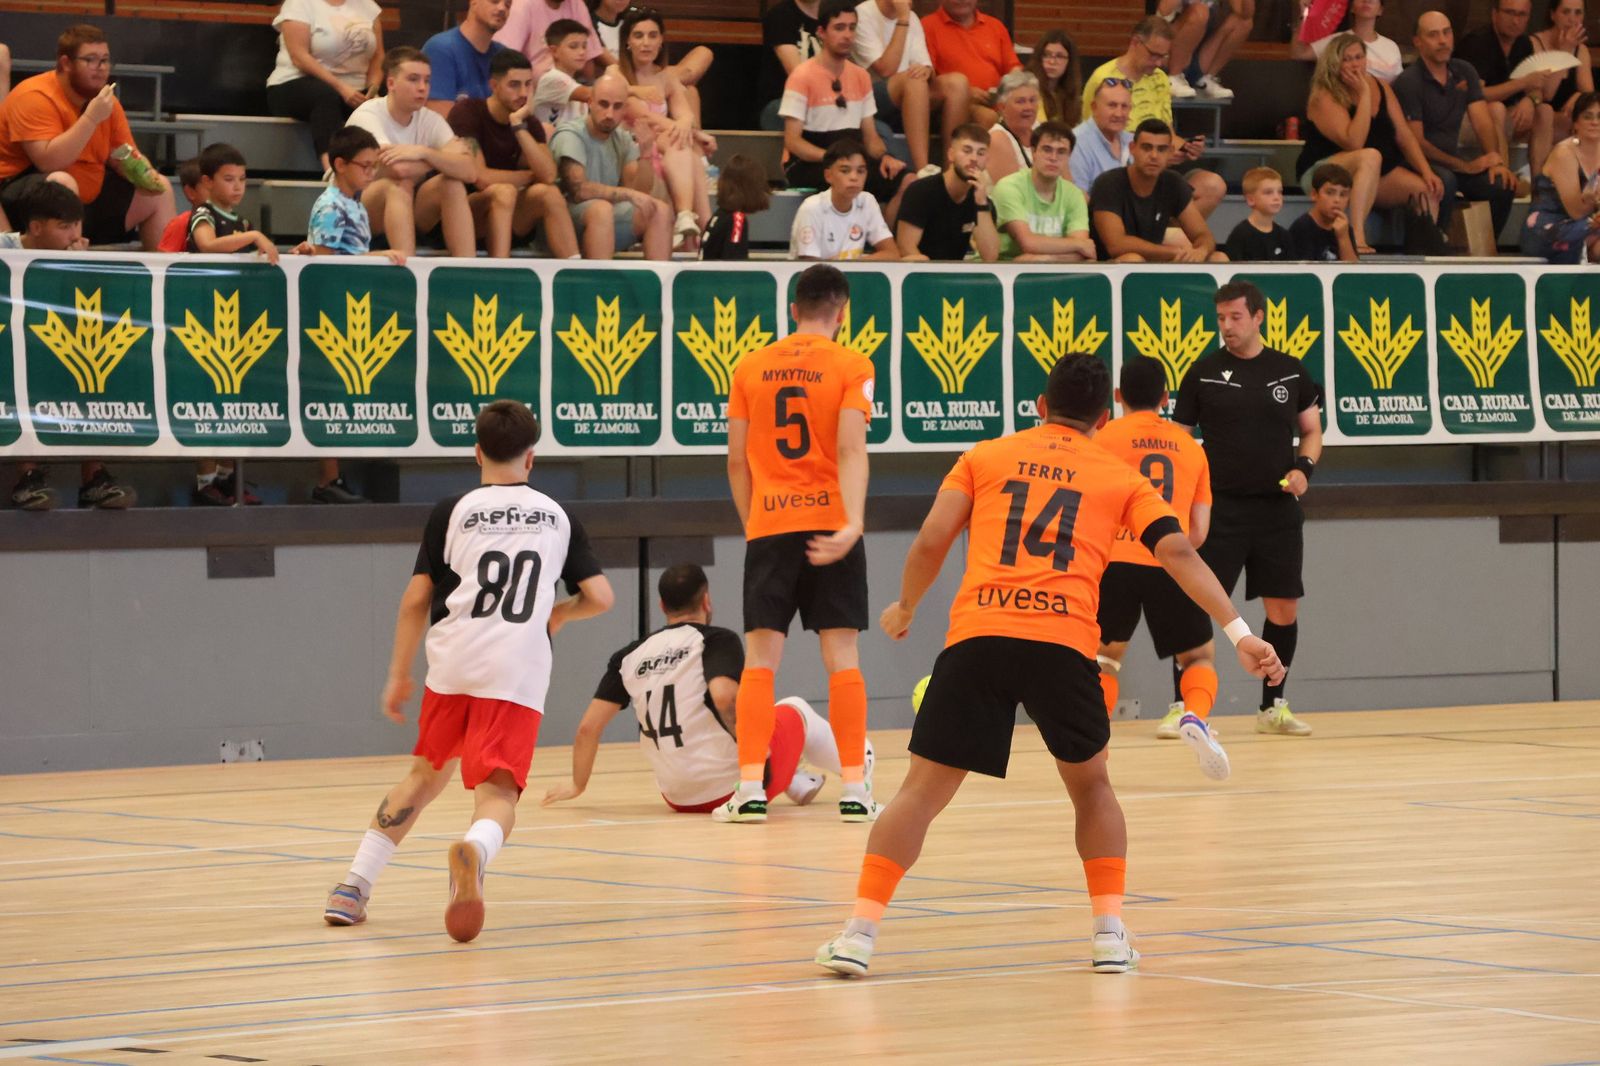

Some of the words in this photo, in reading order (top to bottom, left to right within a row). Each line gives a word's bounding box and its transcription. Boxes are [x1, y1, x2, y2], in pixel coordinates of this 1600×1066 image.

[762, 369, 823, 383] MYKYTIUK
[905, 401, 946, 419] CAJA
[950, 401, 1000, 417] RURAL
[1018, 400, 1041, 417] CA
[1340, 397, 1374, 412] CAJA
[1378, 396, 1427, 412] RURAL
[1443, 395, 1482, 411] CAJA
[1482, 394, 1530, 410] RURAL
[1545, 394, 1581, 410] CAJA
[35, 402, 84, 420] CAJA
[88, 402, 152, 420] RURAL
[172, 402, 219, 421] CAJA
[223, 402, 285, 420] RURAL
[305, 403, 349, 421] CAJA
[353, 403, 413, 420] RURAL
[432, 402, 476, 421] CAJA
[556, 403, 598, 421] CAJA
[601, 403, 658, 420] RURAL
[676, 402, 717, 420] CAJA
[1356, 414, 1369, 425] DE
[1373, 414, 1414, 425] ZAMORA
[1460, 412, 1474, 423] DE
[1477, 412, 1518, 422] ZAMORA
[1562, 411, 1576, 422] DE
[60, 423, 78, 433] DE
[82, 424, 135, 433] ZAMORA
[195, 422, 212, 433] DE
[216, 423, 268, 434] ZAMORA
[326, 423, 343, 434] DE
[347, 424, 396, 434] ZAMORA
[452, 423, 469, 434] DE
[575, 423, 591, 434] DE
[594, 423, 640, 434] ZAMORA
[693, 422, 708, 433] DE
[775, 386, 811, 459] 5
[923, 420, 937, 431] DE
[940, 420, 984, 431] ZAMORA
[1132, 439, 1180, 452] SAMUEL
[1018, 461, 1076, 483] TERRY
[1140, 454, 1173, 504] 9
[764, 491, 830, 511] uvesa
[1000, 480, 1083, 572] 14
[471, 550, 541, 624] 80
[978, 588, 1069, 615] uvesa
